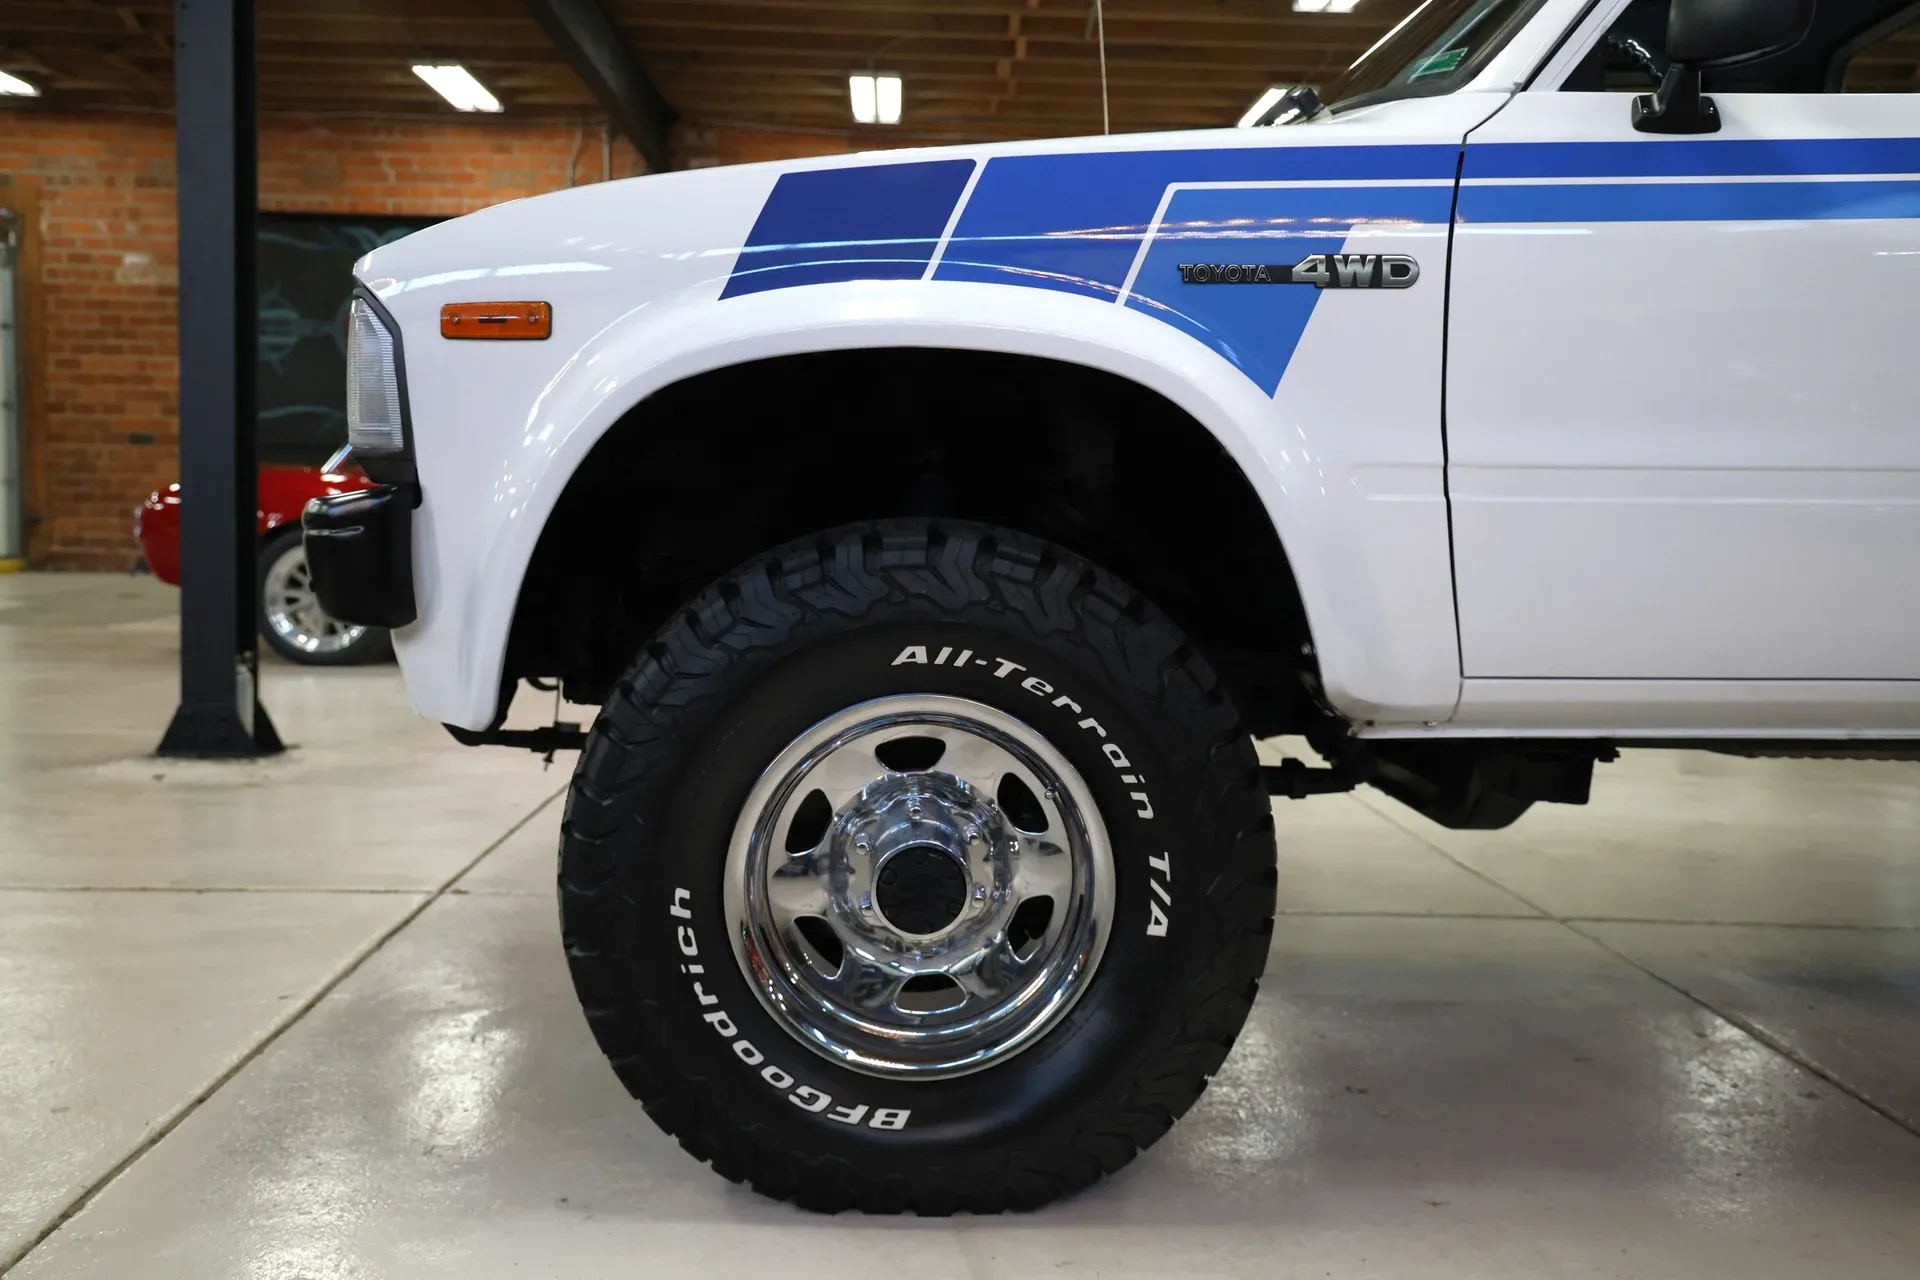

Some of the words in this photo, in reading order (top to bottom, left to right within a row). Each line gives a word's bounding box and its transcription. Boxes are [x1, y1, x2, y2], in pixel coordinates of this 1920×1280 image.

[1179, 264, 1271, 282] TOYOTA
[1291, 254, 1420, 288] 4WD
[891, 645, 1154, 819] All-Terrain
[1146, 851, 1171, 937] T/A
[670, 887, 911, 1130] BFGoodrich
